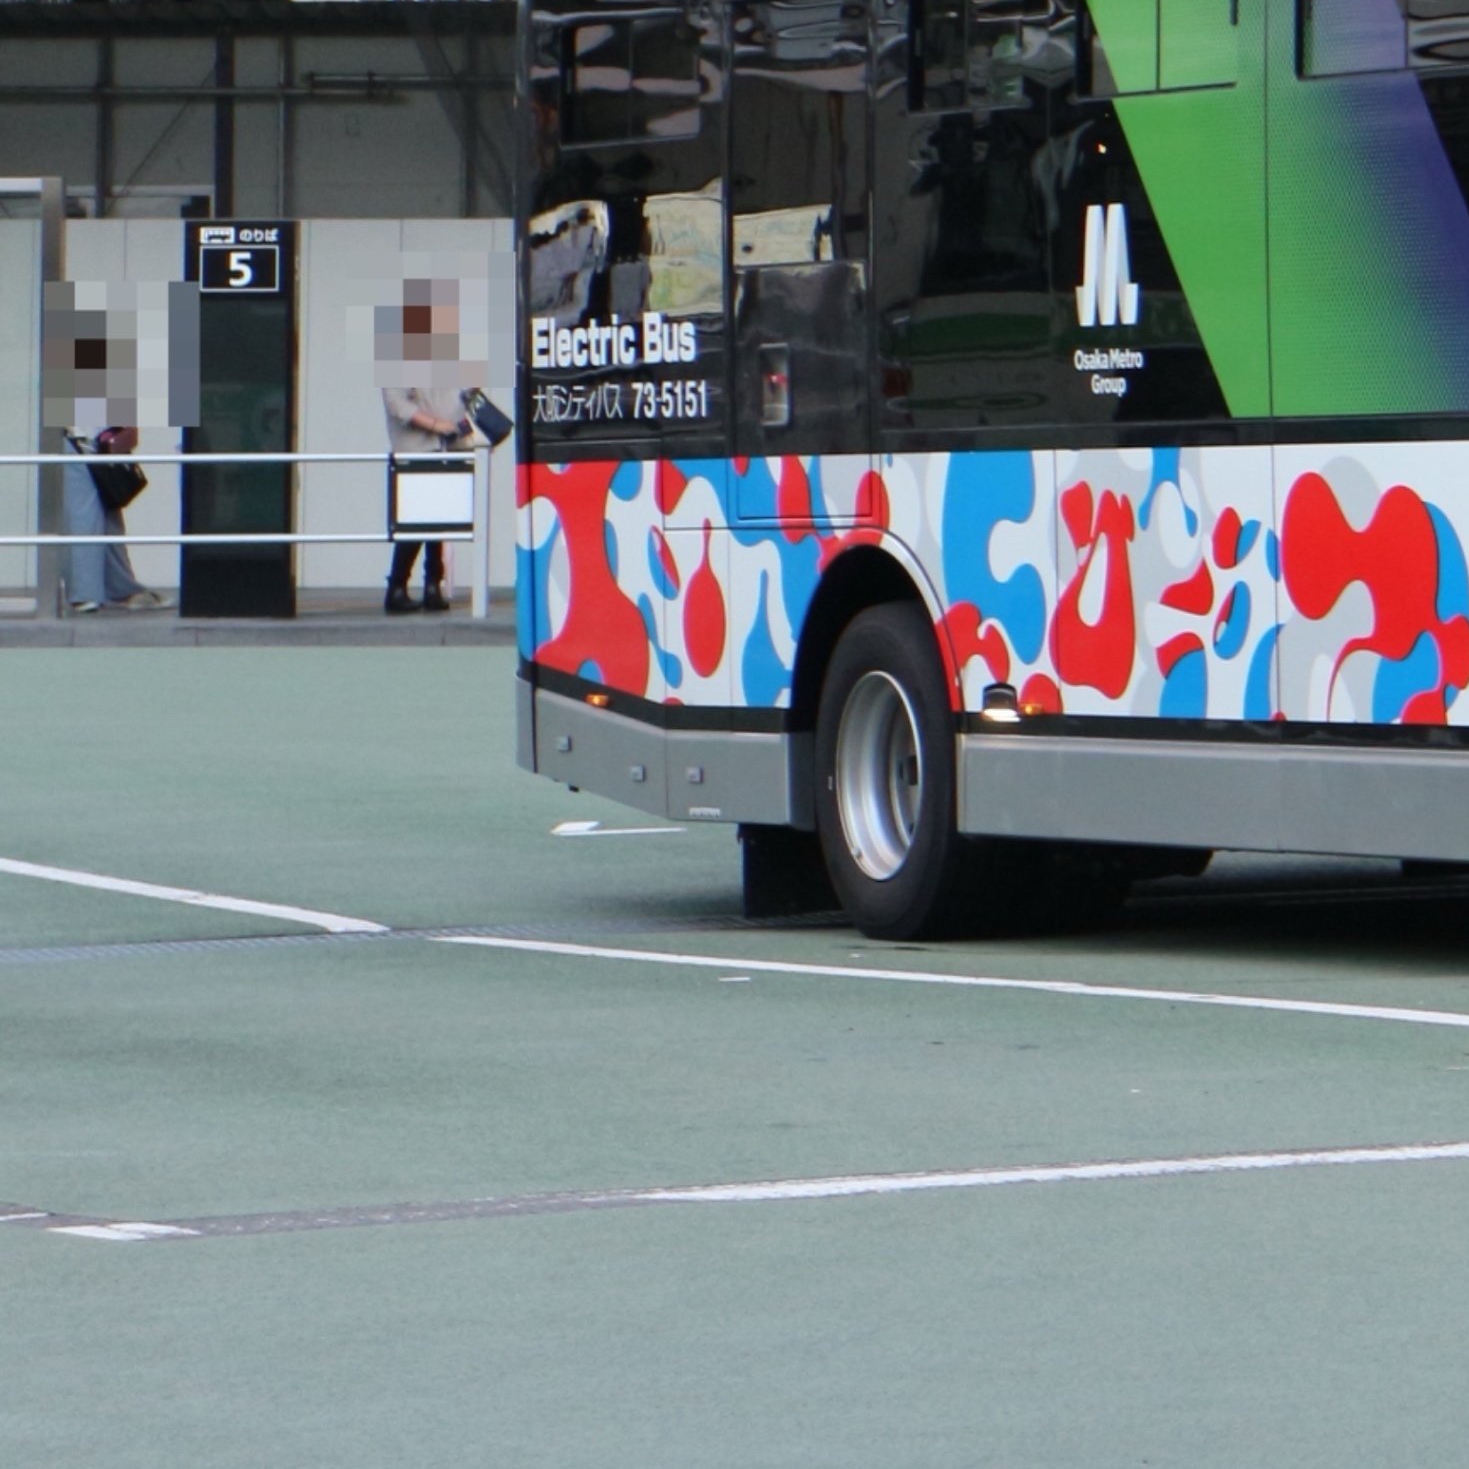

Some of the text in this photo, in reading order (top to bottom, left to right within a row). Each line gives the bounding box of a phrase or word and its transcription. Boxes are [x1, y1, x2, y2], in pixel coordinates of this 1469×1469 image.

[239, 228, 278, 242] のりば
[229, 251, 252, 287] 5
[531, 311, 696, 368] Electric Bus
[1074, 348, 1143, 370] Osaka Metro
[632, 379, 707, 419] 73-5151
[1091, 374, 1127, 397] Group
